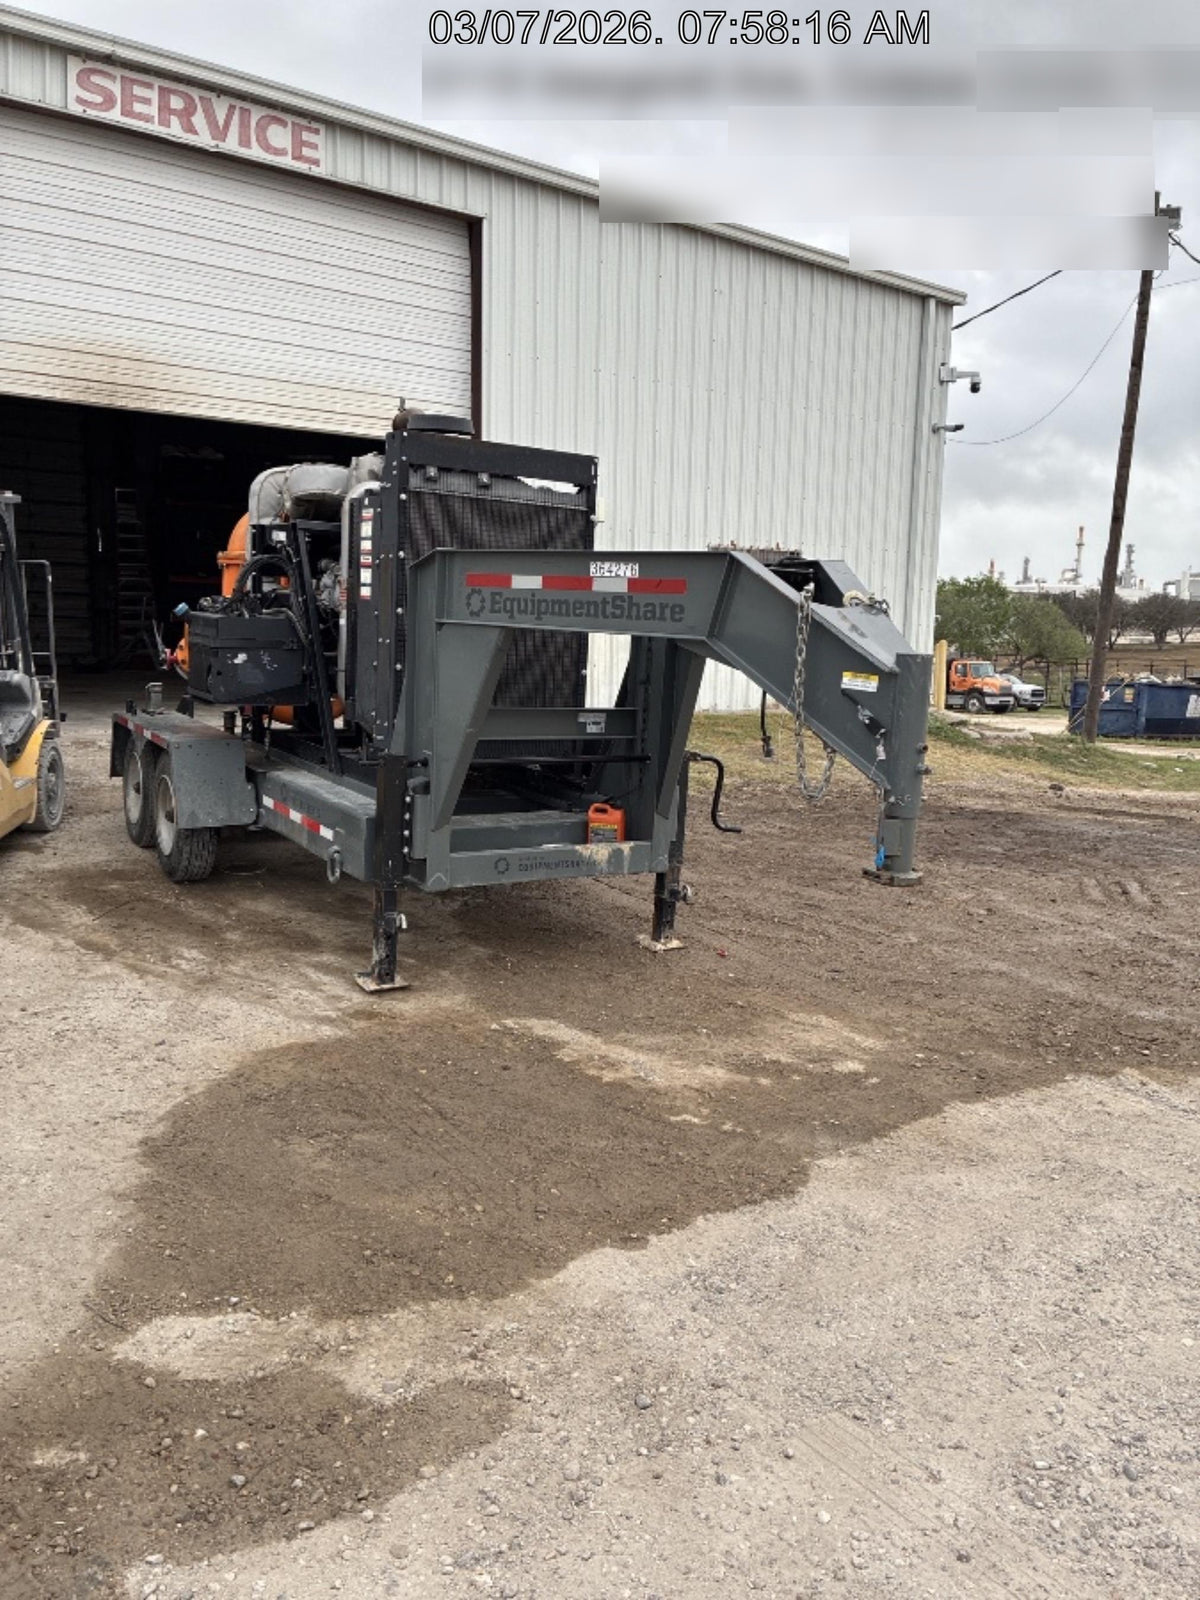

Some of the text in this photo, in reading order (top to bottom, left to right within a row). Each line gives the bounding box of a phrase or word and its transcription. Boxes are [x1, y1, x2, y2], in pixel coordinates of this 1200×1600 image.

[75, 66, 321, 168] SERVICE
[591, 561, 638, 577] 364276
[489, 592, 685, 623] EquipmentShare
